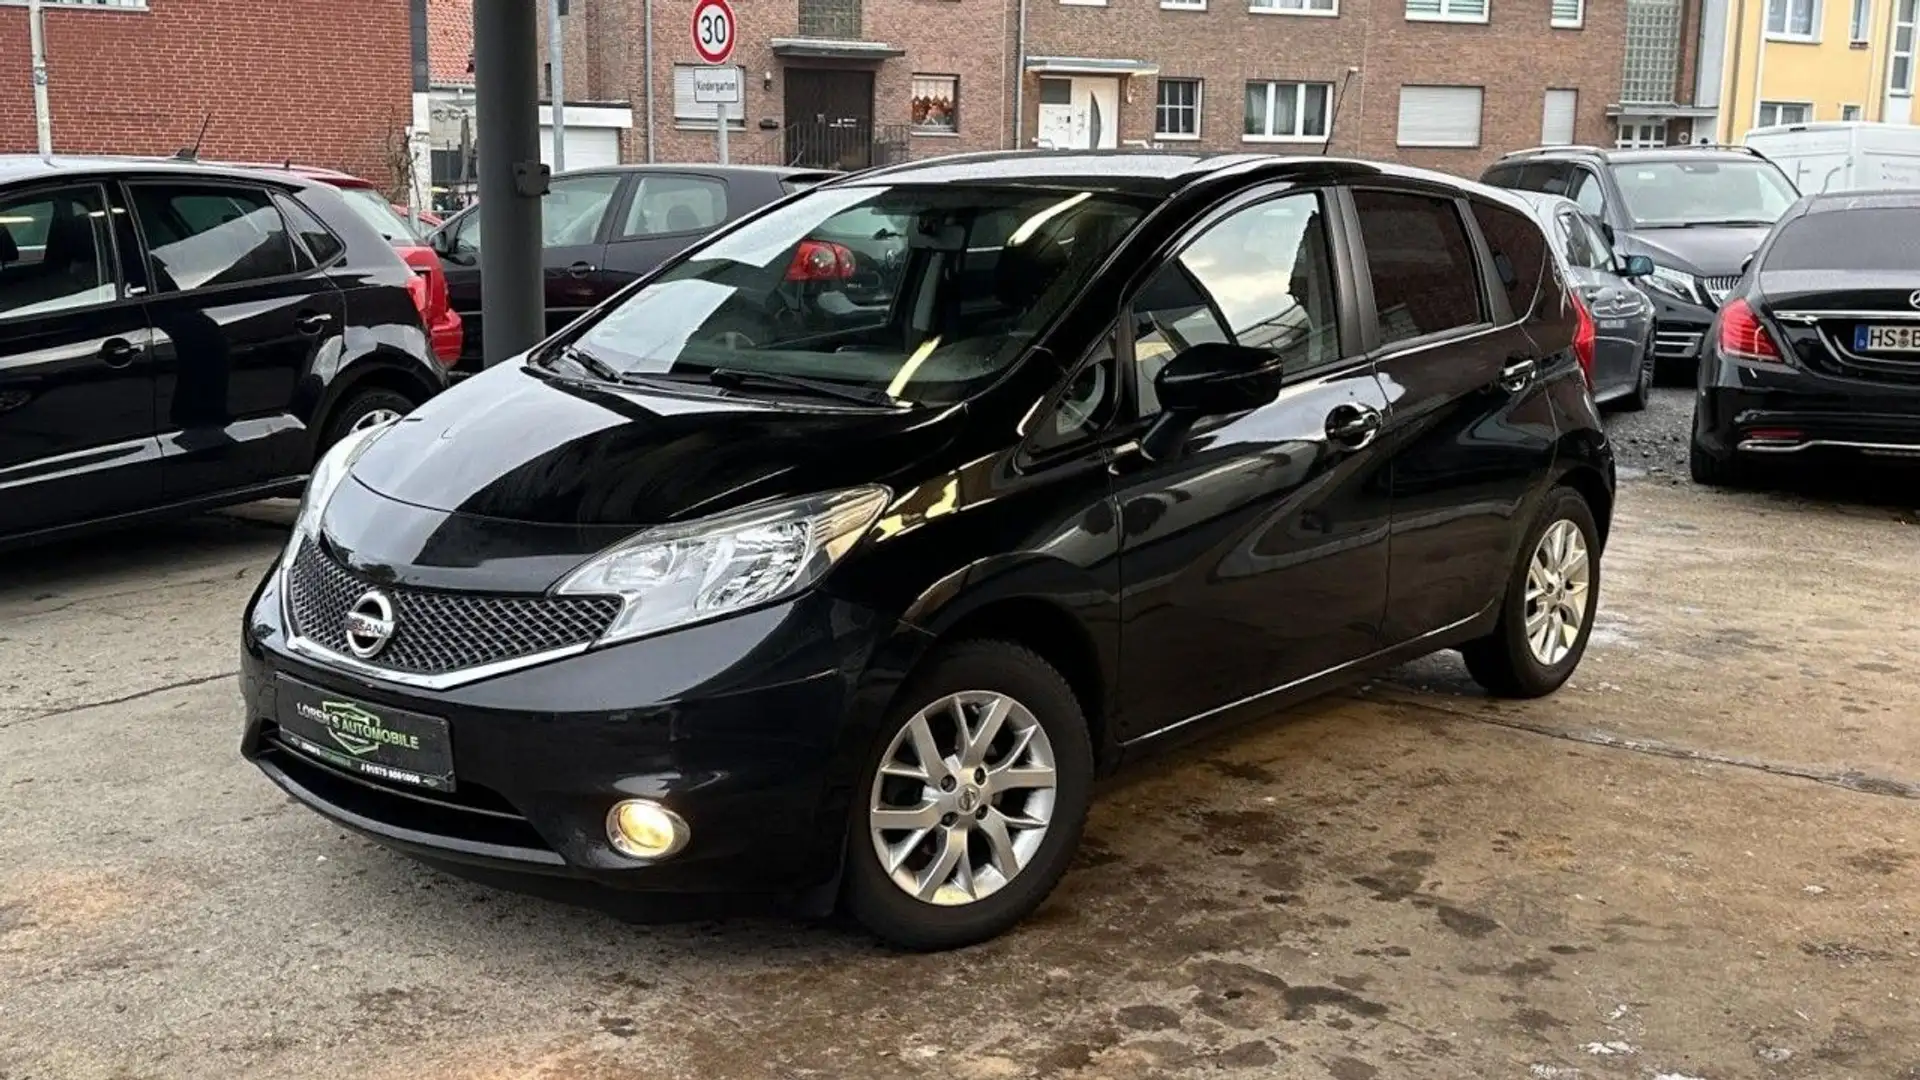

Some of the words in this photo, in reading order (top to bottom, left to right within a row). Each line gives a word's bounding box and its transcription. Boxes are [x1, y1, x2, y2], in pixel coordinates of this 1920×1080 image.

[701, 14, 726, 44] 30
[1870, 329, 1897, 347] HS
[341, 718, 420, 750] AUTOMOBILE
